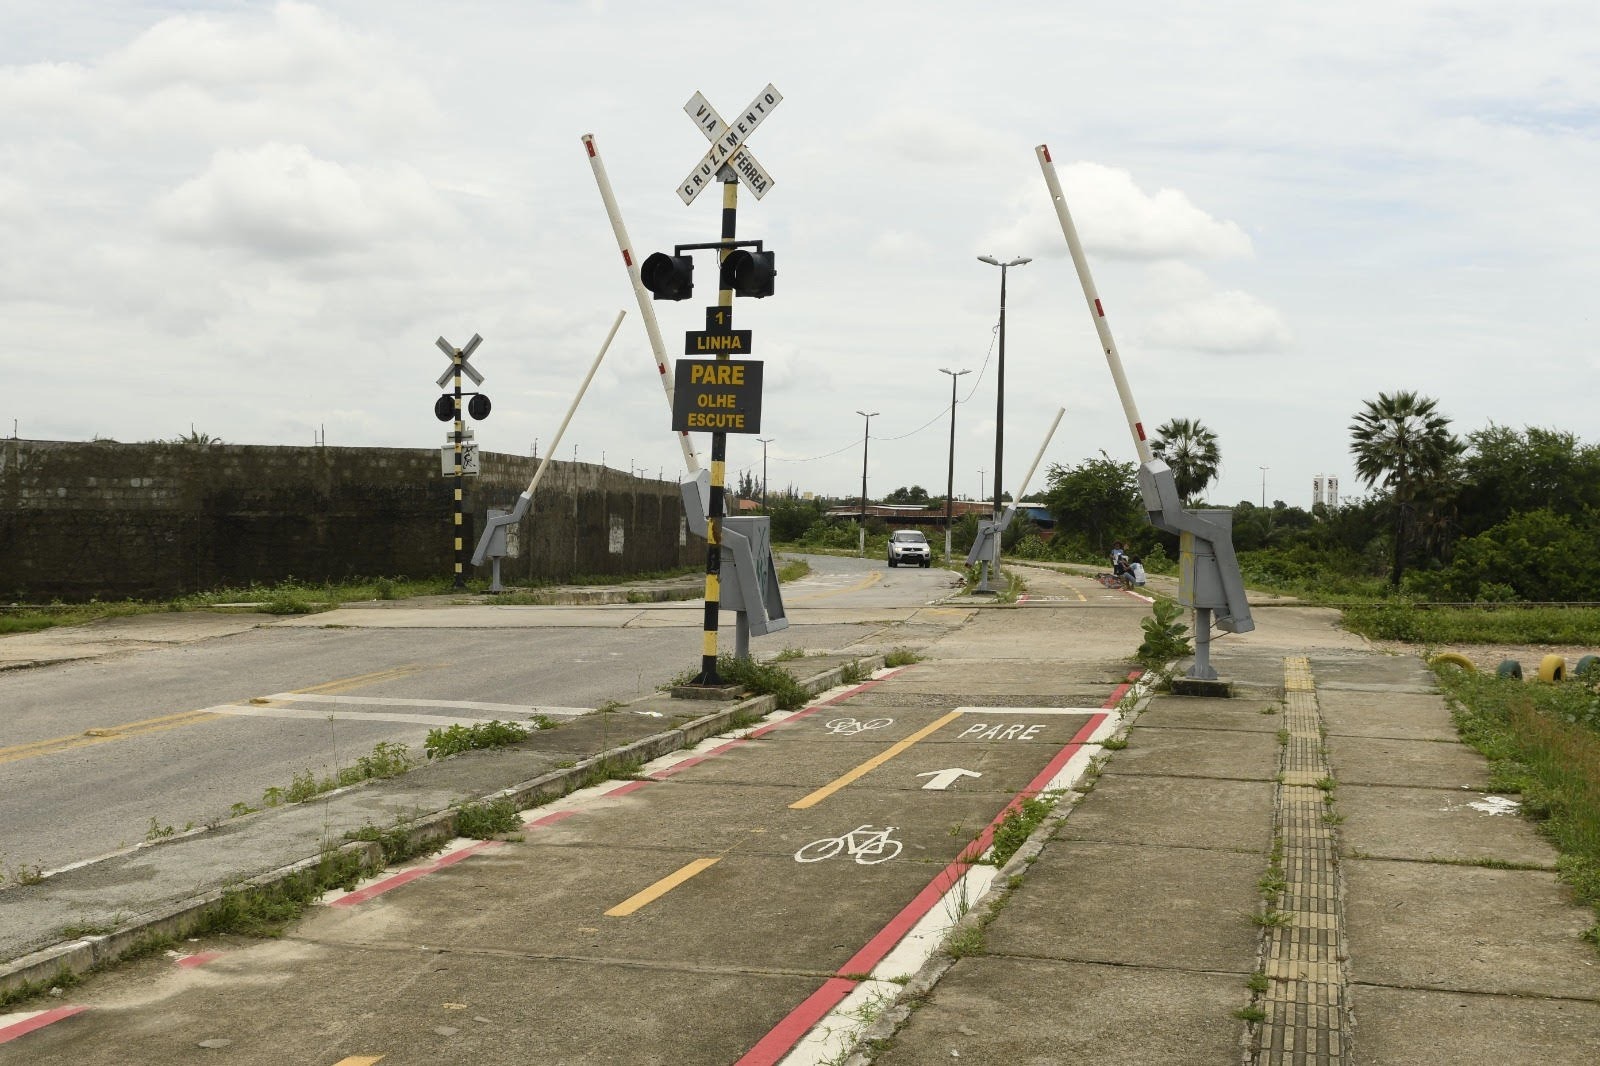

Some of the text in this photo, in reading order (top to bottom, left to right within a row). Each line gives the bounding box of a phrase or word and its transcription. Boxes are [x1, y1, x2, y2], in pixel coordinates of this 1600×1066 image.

[695, 104, 717, 132] VIA
[685, 93, 775, 196] CRUZAMENTO
[715, 311, 723, 325] 1
[697, 335, 742, 350] LINHA
[691, 364, 745, 385] PARE
[697, 393, 736, 408] OLHE
[687, 412, 745, 428] ESCUTE
[957, 723, 1046, 740] PARE
